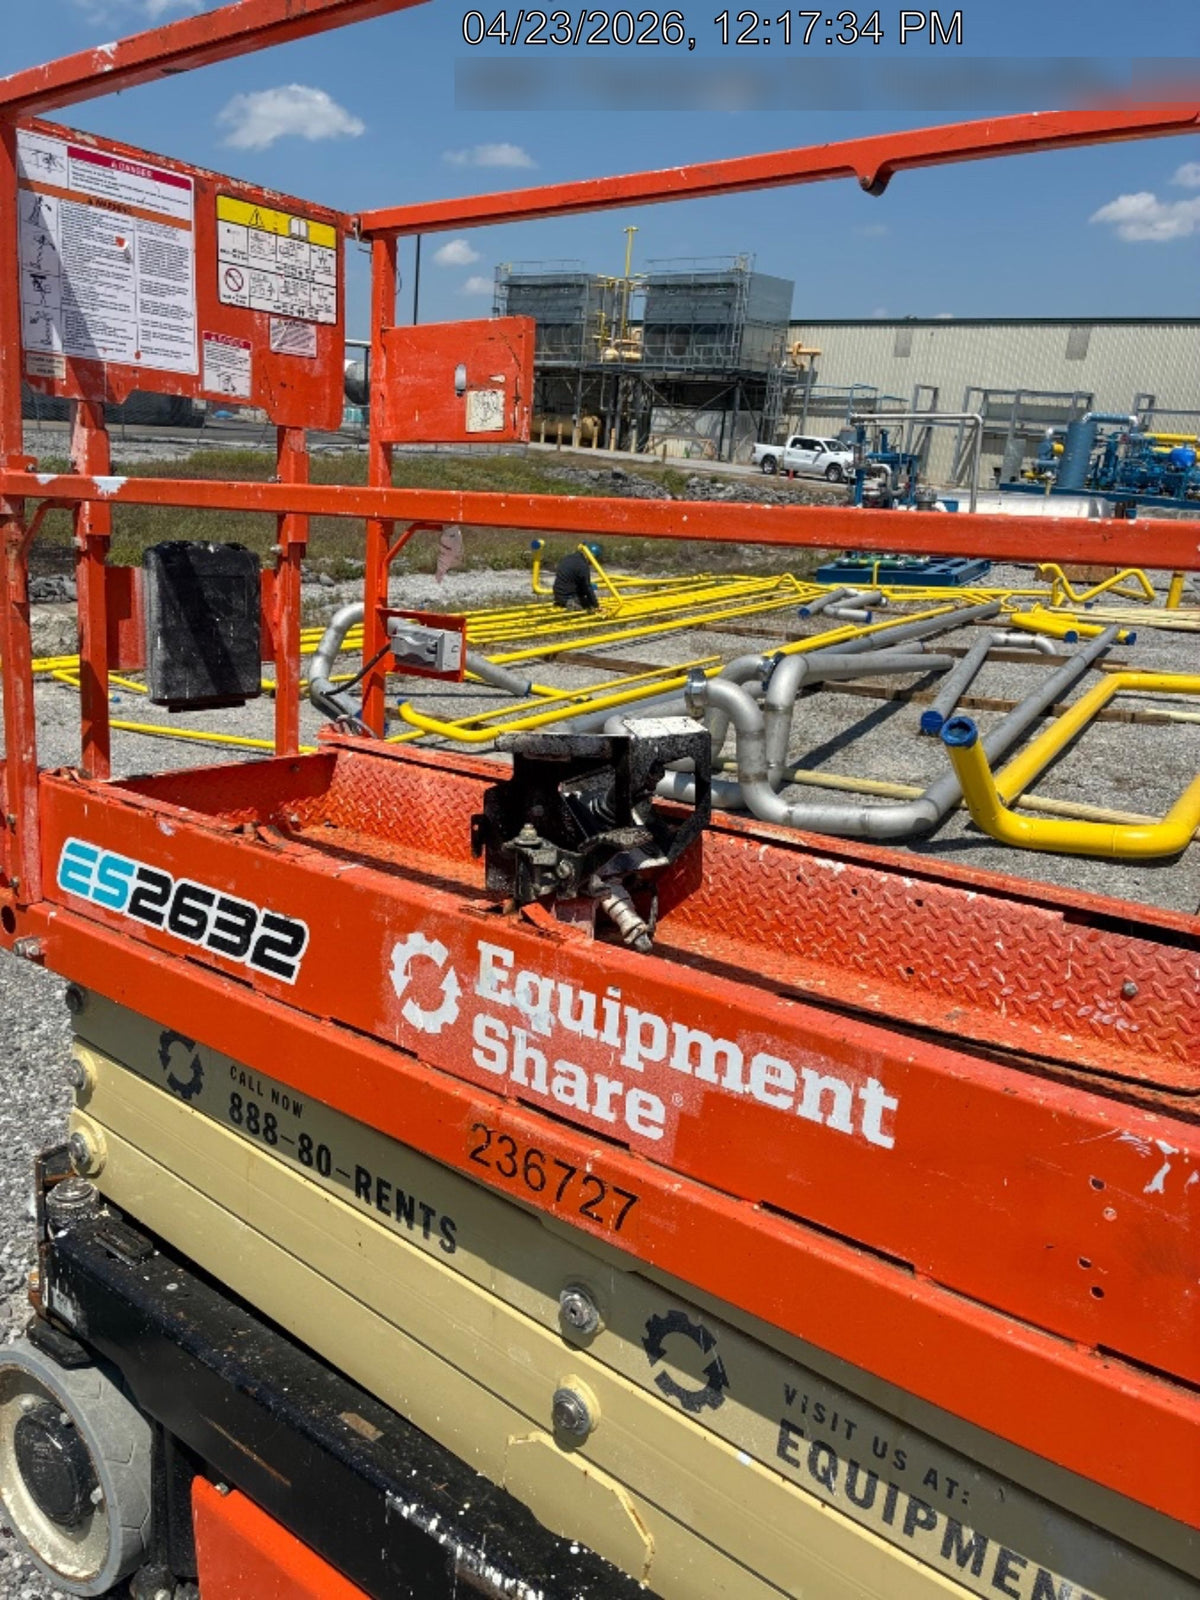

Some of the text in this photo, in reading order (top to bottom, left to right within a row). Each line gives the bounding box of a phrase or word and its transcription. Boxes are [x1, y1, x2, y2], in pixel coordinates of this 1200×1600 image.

[59, 840, 308, 981] ES2632
[230, 1065, 303, 1119] CALL NOW
[474, 939, 899, 1150] Equipment
[228, 1091, 458, 1254] 888-80-RENTS
[469, 1122, 639, 1231] 236727
[783, 1382, 969, 1505] VISIT US AT:
